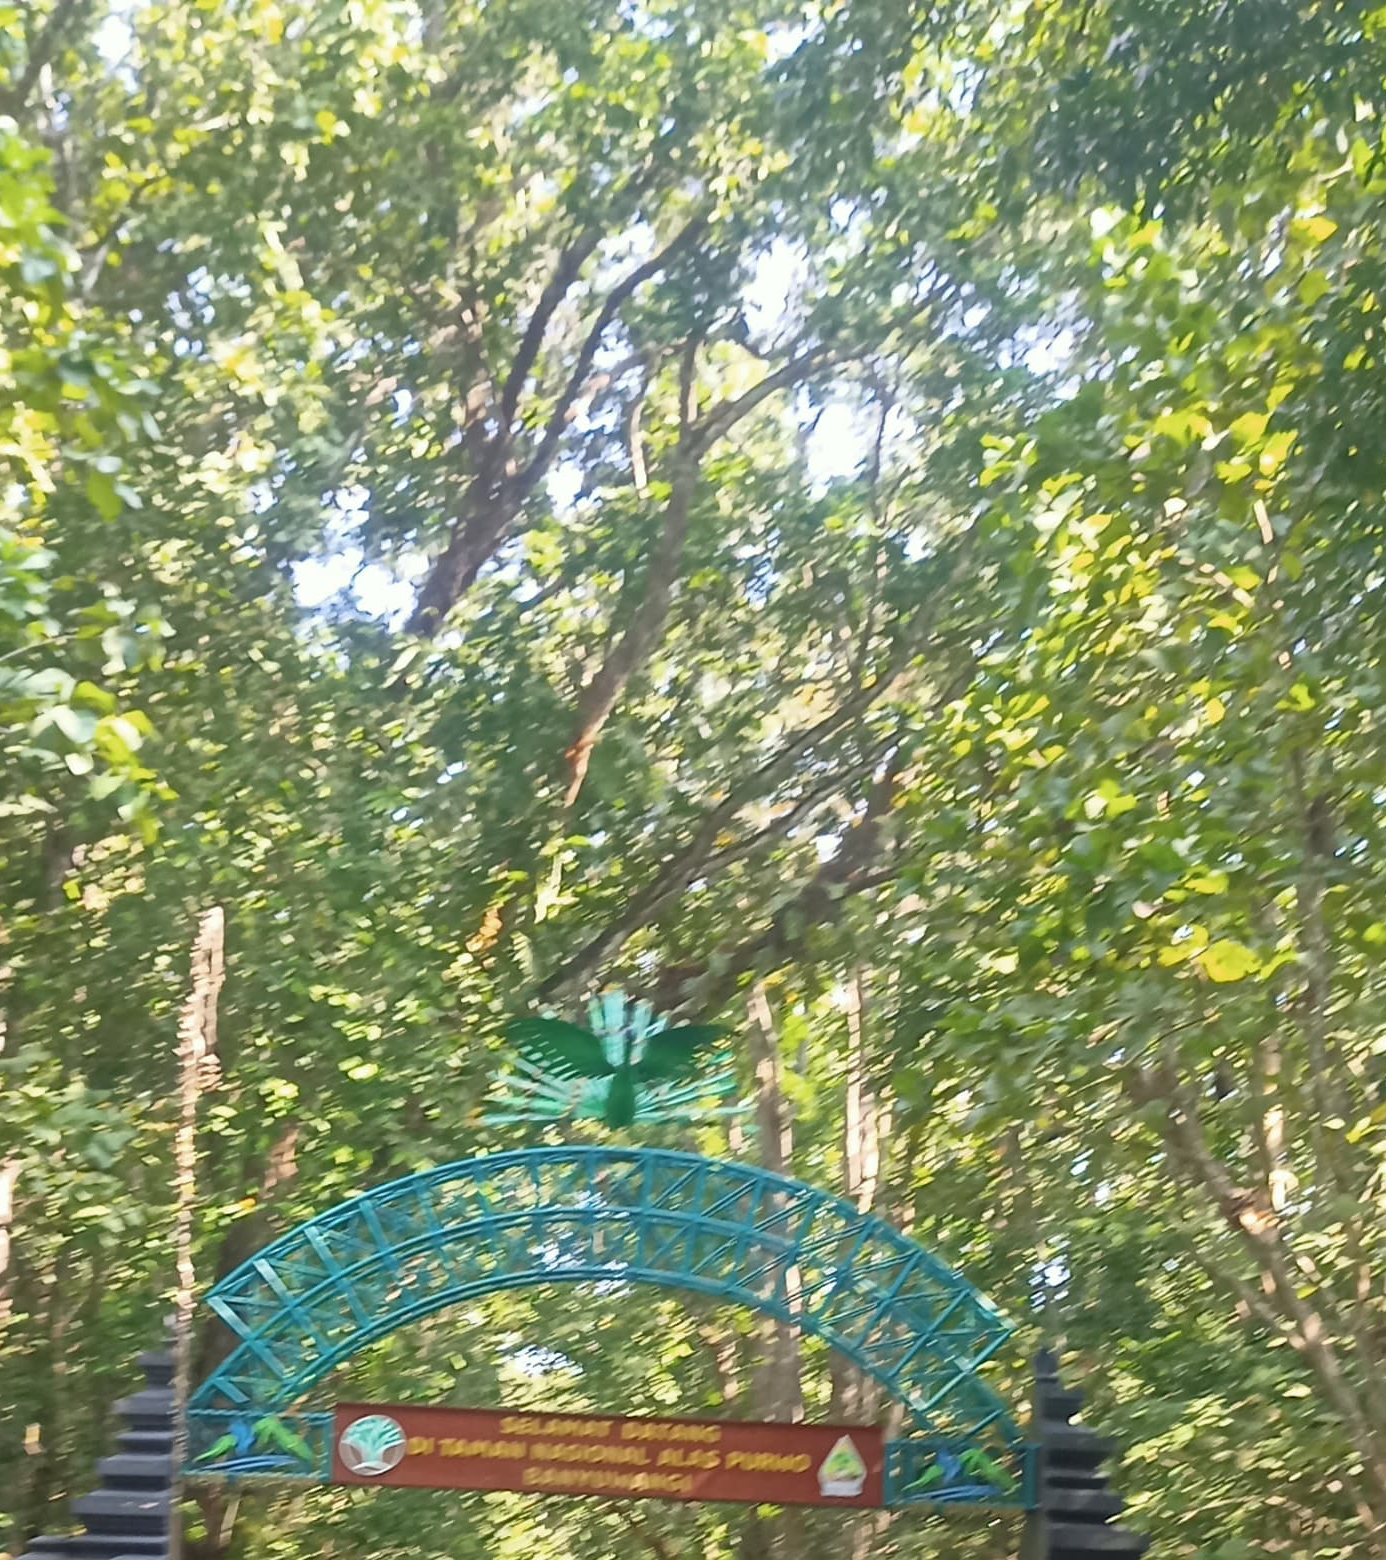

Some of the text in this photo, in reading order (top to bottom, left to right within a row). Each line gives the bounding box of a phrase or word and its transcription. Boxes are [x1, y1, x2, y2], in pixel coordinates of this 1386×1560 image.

[499, 1416, 722, 1443] SELAMAT DATANG
[408, 1436, 811, 1473] DI TAMAN NASIONAL ALAS PURWO
[522, 1466, 694, 1492] BANYUWANGI
